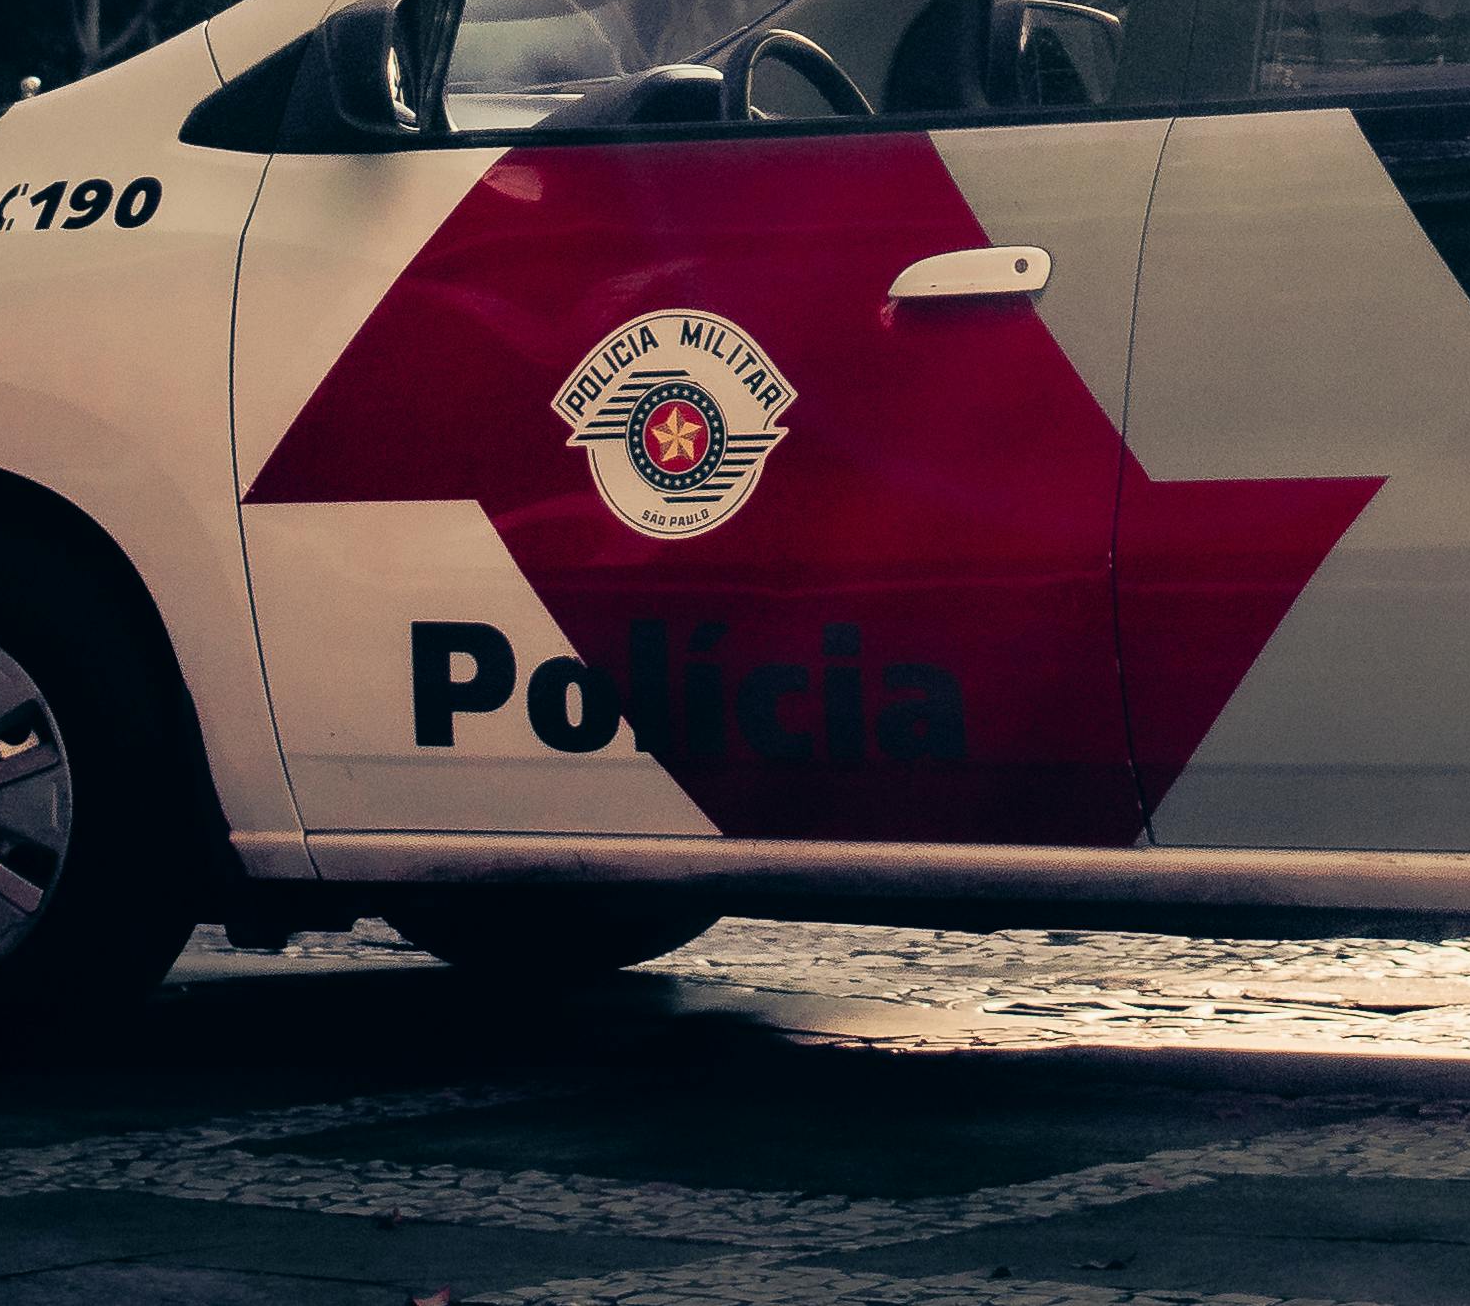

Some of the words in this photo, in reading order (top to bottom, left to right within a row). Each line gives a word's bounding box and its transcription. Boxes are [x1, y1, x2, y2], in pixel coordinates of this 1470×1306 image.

[30, 176, 163, 230] 190
[564, 325, 659, 418] POLICIA
[680, 319, 783, 411] MILITAR
[641, 509, 666, 526] SÃO
[669, 508, 710, 526] PAULO
[410, 619, 968, 761] Polícia
